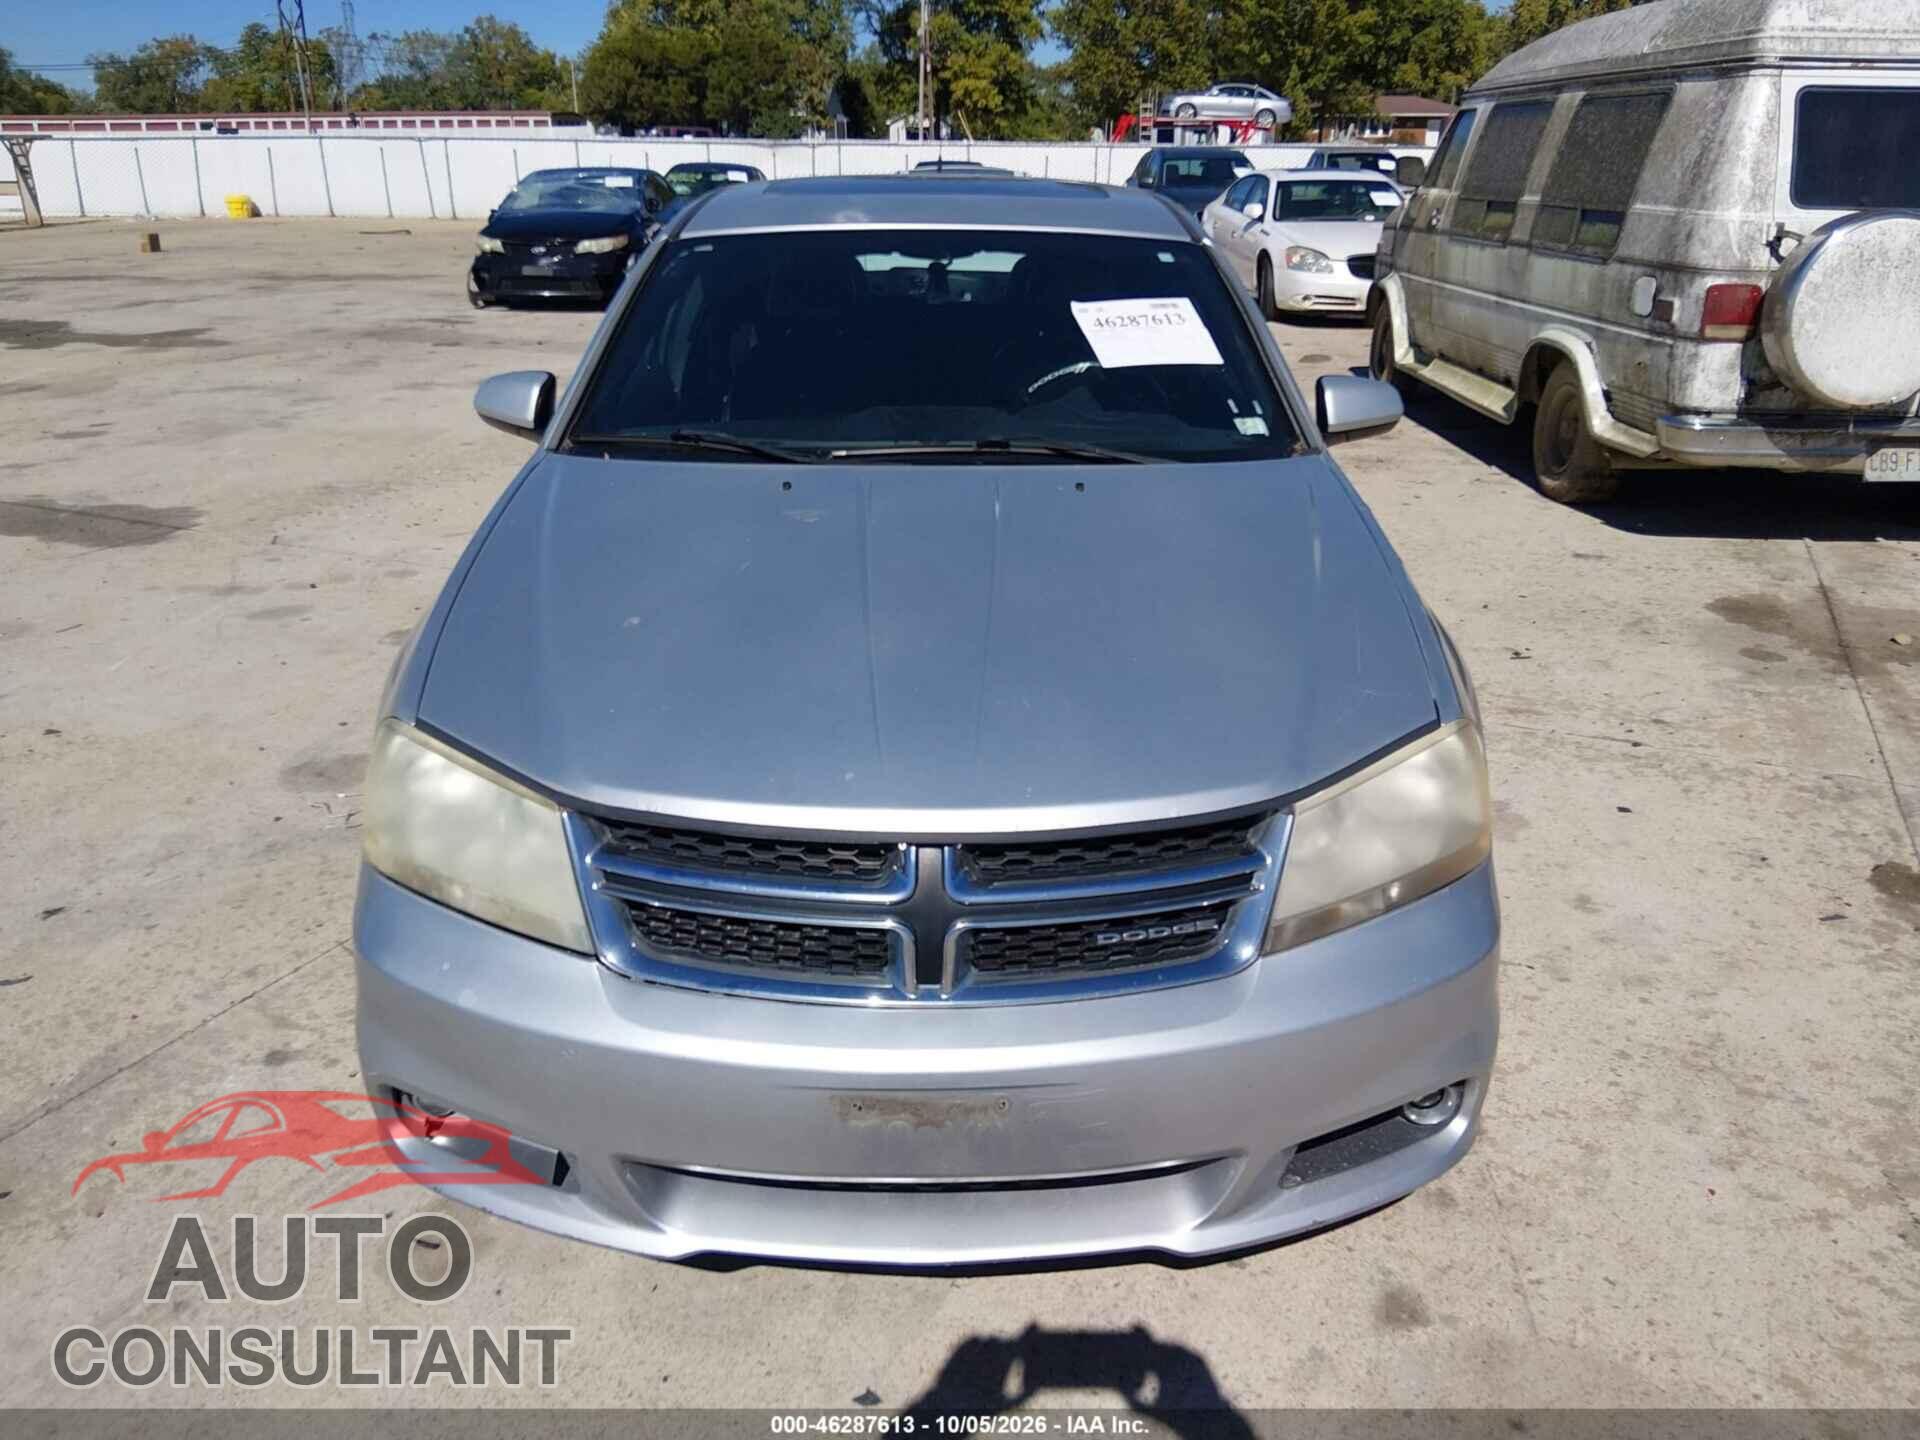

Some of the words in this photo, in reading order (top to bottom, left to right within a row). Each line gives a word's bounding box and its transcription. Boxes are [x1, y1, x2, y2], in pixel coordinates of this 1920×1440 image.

[1093, 312, 1186, 329] 46287613
[1906, 451, 1920, 472] F
[1097, 919, 1218, 944] DODGE
